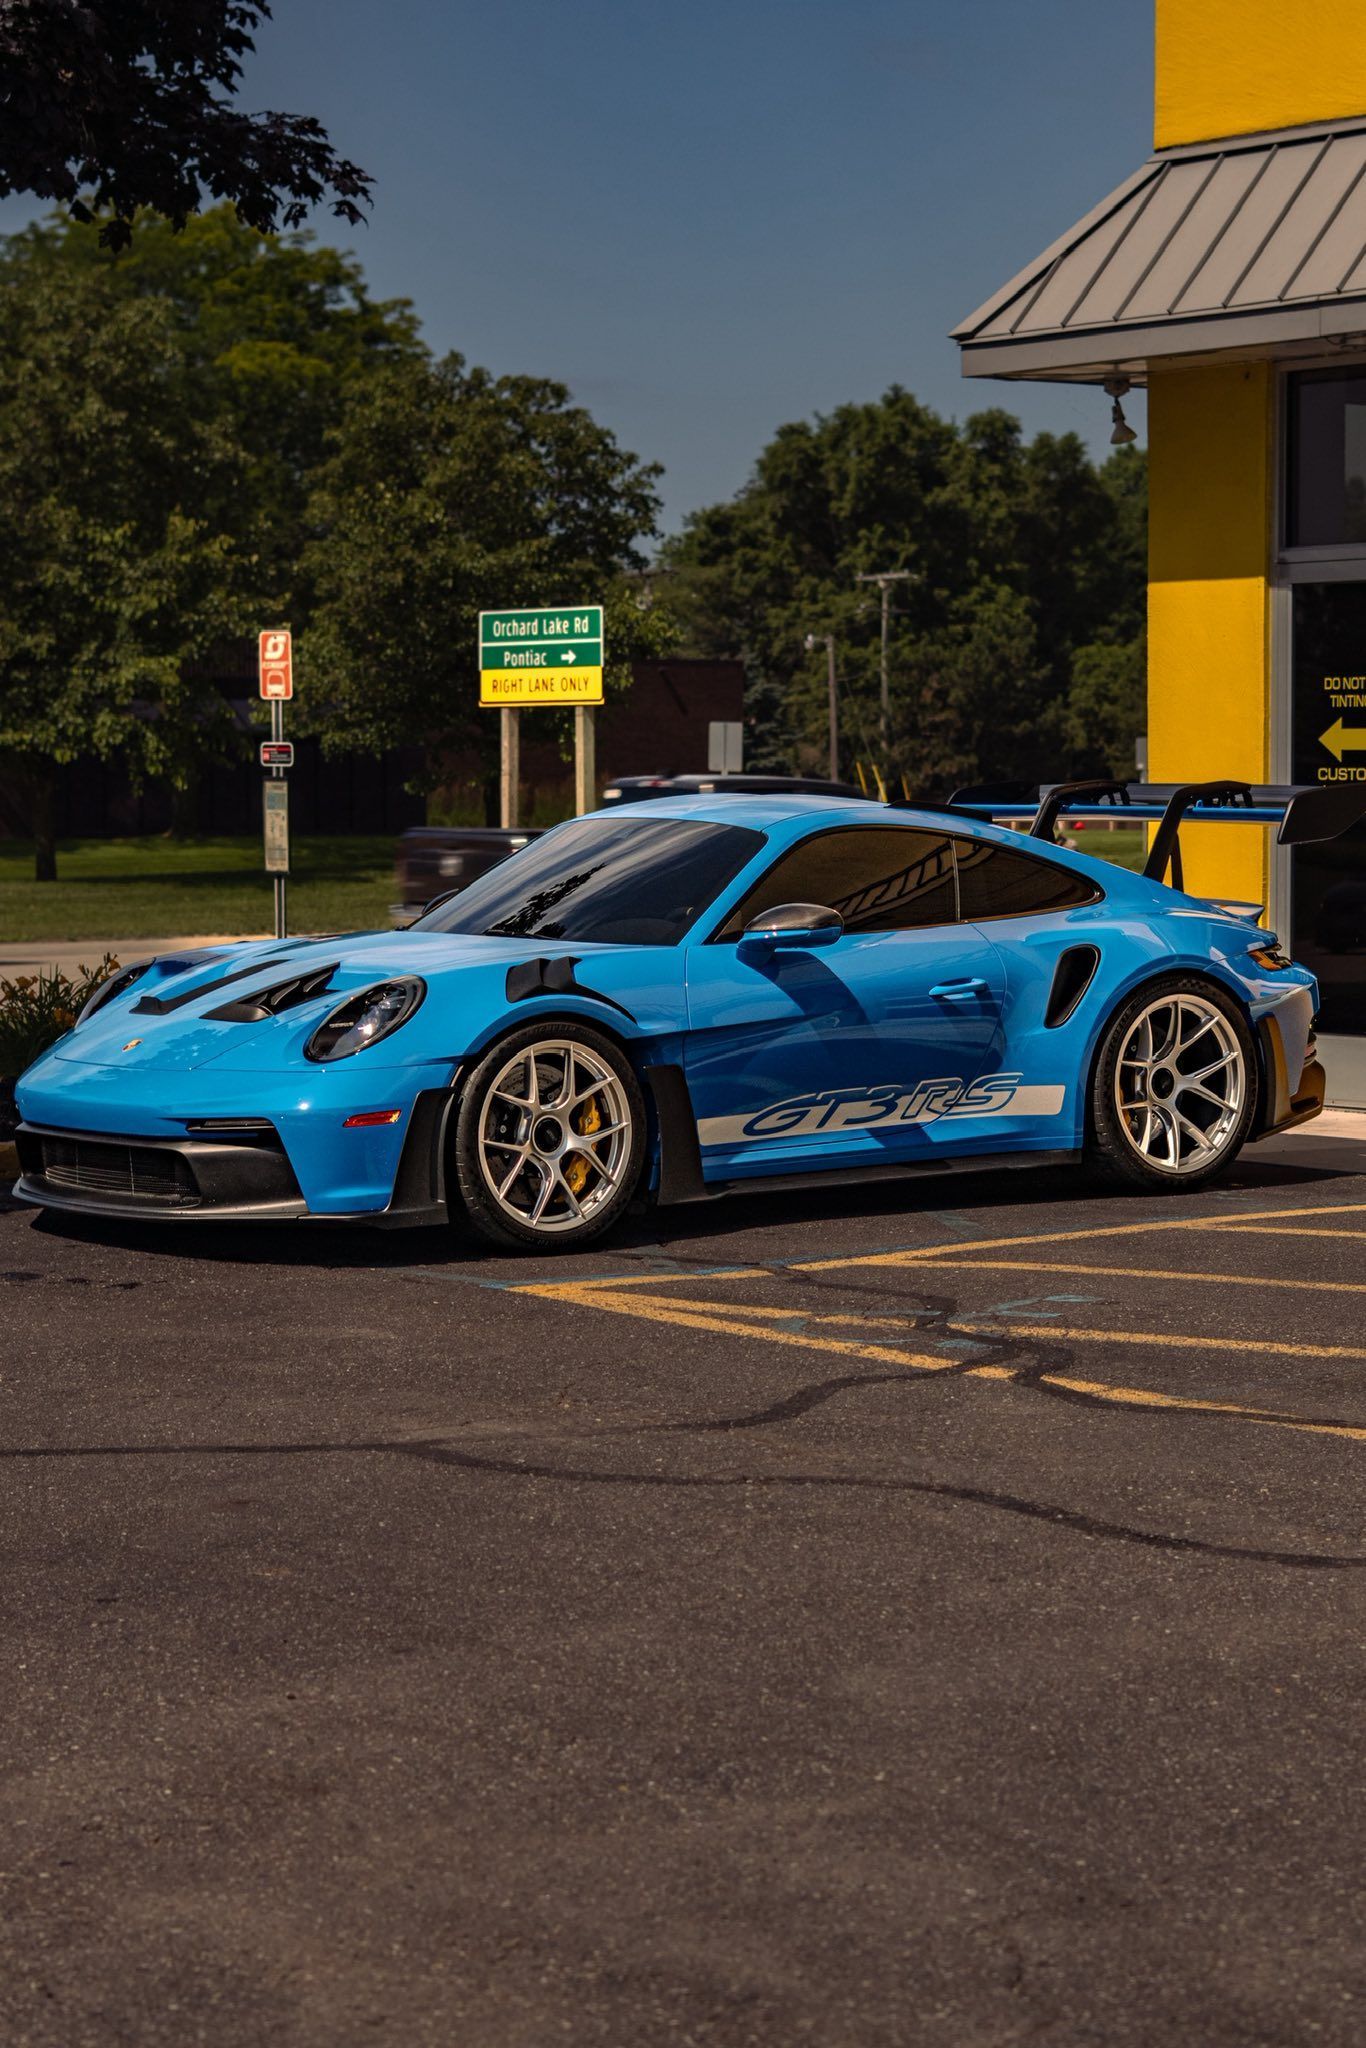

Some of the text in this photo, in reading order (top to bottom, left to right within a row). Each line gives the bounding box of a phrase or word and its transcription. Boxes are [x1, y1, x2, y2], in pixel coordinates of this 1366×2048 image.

[493, 615, 589, 637] Orchard Lake Rd
[504, 649, 547, 667] Pontiac
[492, 677, 589, 693] RIGHT LANE ONLY
[1324, 677, 1366, 690] DO NOT
[1330, 694, 1366, 708] TINTIN
